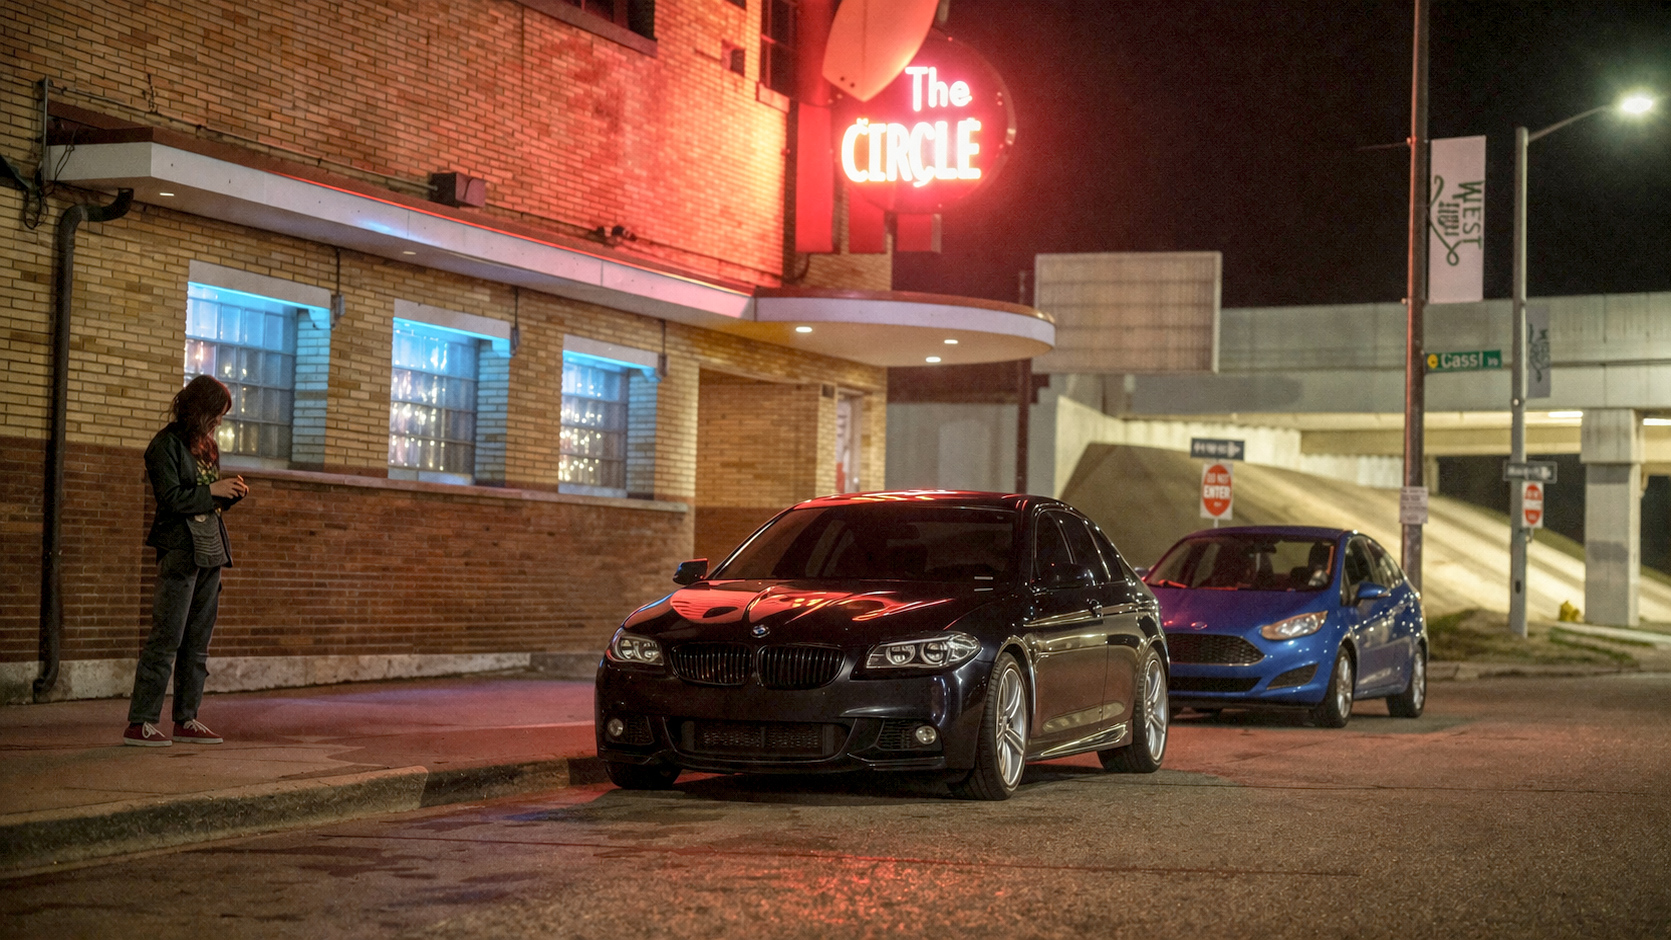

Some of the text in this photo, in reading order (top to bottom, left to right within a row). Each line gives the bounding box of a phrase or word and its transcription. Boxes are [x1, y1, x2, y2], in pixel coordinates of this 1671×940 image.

[905, 66, 972, 112] The
[841, 118, 981, 188] CIRCLE
[1452, 180, 1485, 250] WEST
[1203, 485, 1232, 500] ENTER
